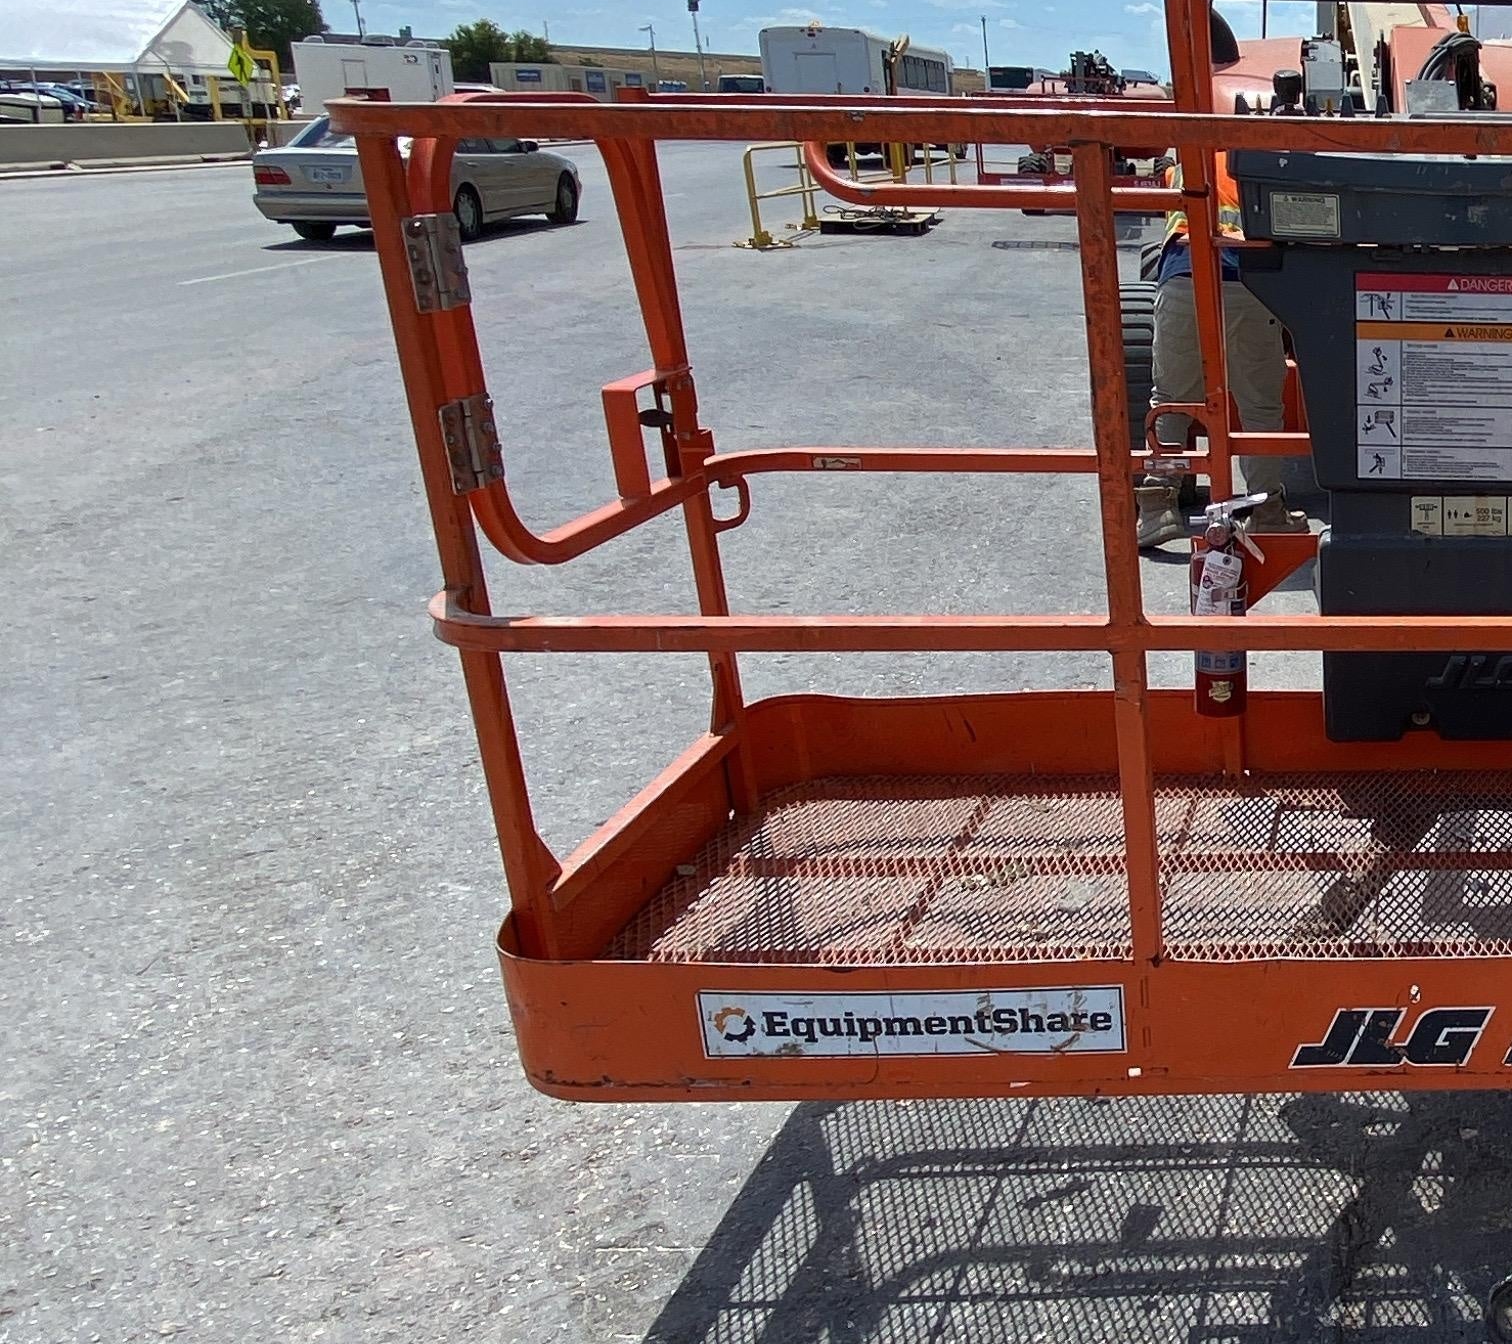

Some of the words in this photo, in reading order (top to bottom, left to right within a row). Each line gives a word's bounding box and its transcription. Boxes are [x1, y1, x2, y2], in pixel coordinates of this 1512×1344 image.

[1460, 278, 1512, 292] DANGER
[761, 1007, 1112, 1043] EquipmentShare
[1288, 1004, 1497, 1069] JLG
